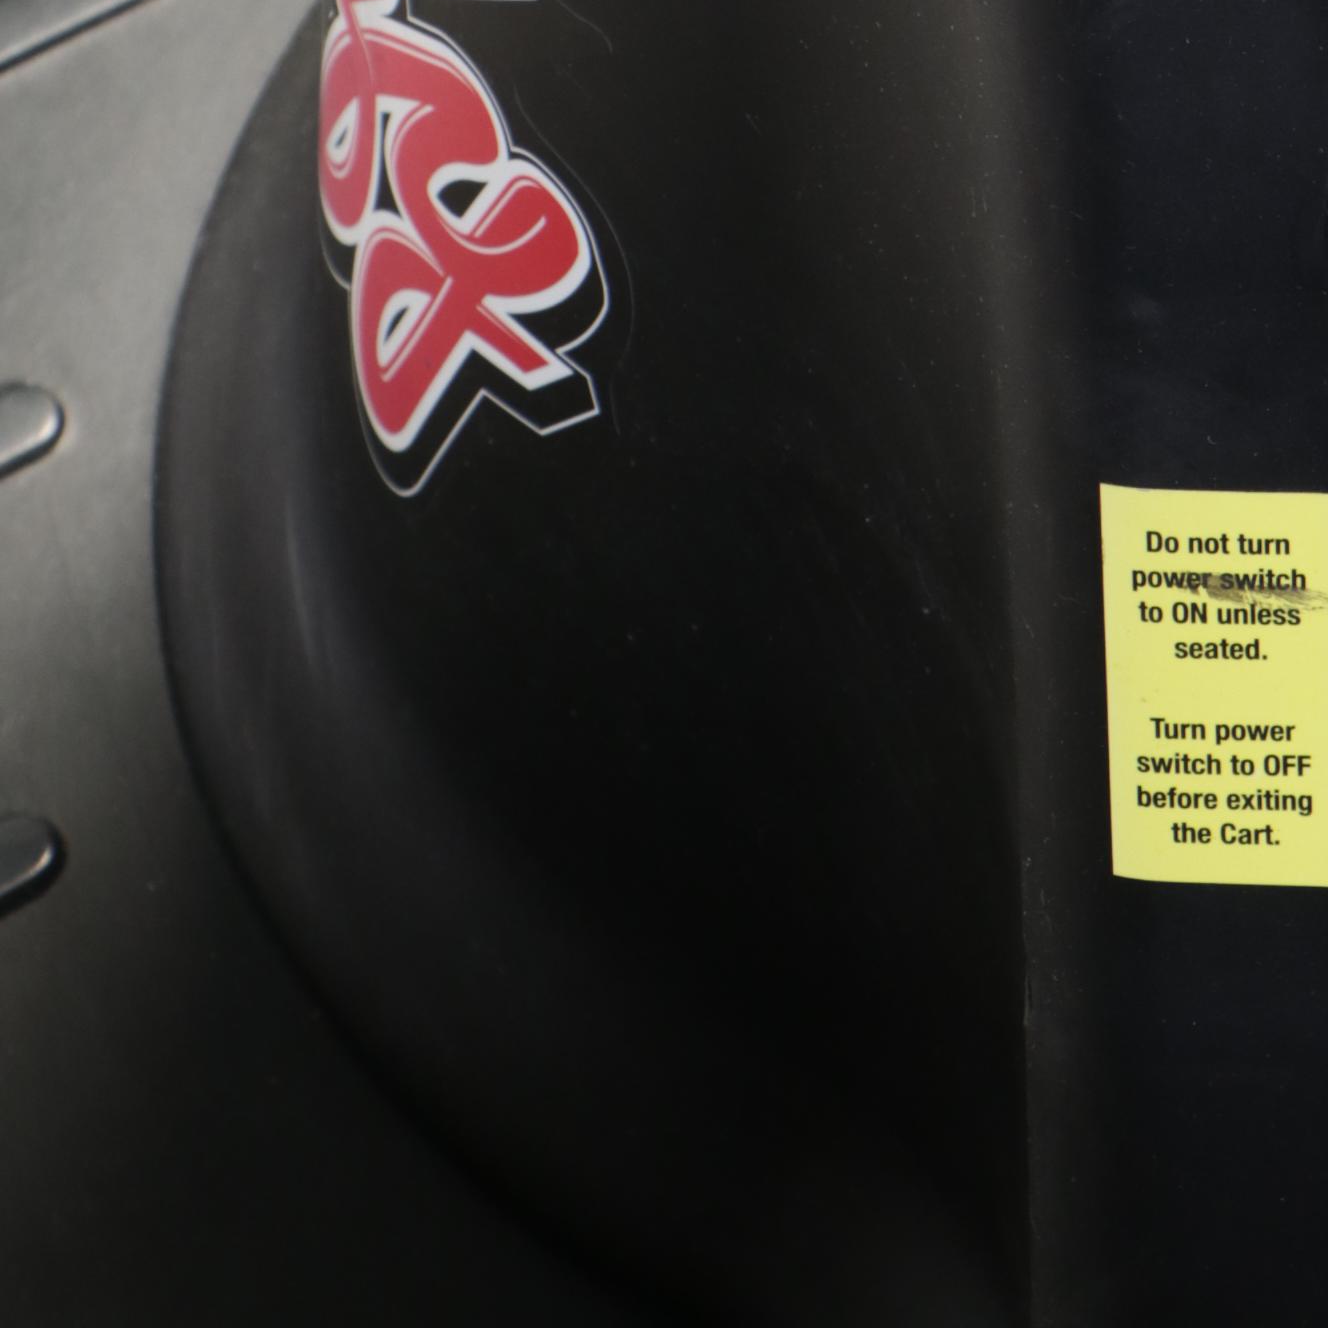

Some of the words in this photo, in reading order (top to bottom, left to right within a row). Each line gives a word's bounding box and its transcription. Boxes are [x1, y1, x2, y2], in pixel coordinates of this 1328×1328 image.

[1145, 530, 1179, 555] Do
[1187, 532, 1229, 555] not
[1237, 533, 1291, 556] turn
[1131, 569, 1212, 592] power
[1219, 569, 1306, 592] switch
[1138, 601, 1163, 624] to
[1171, 601, 1208, 625] ON
[1217, 603, 1301, 626] unless
[1174, 638, 1268, 661] seated.
[1149, 718, 1206, 741] Turn
[1214, 722, 1295, 746] power
[1135, 753, 1221, 776] switch
[1230, 754, 1255, 776] to
[1263, 755, 1312, 777] OFF
[1135, 786, 1218, 810] before
[1226, 789, 1313, 817] exiting
[1171, 822, 1211, 844] the
[1220, 823, 1281, 846] Cart.
